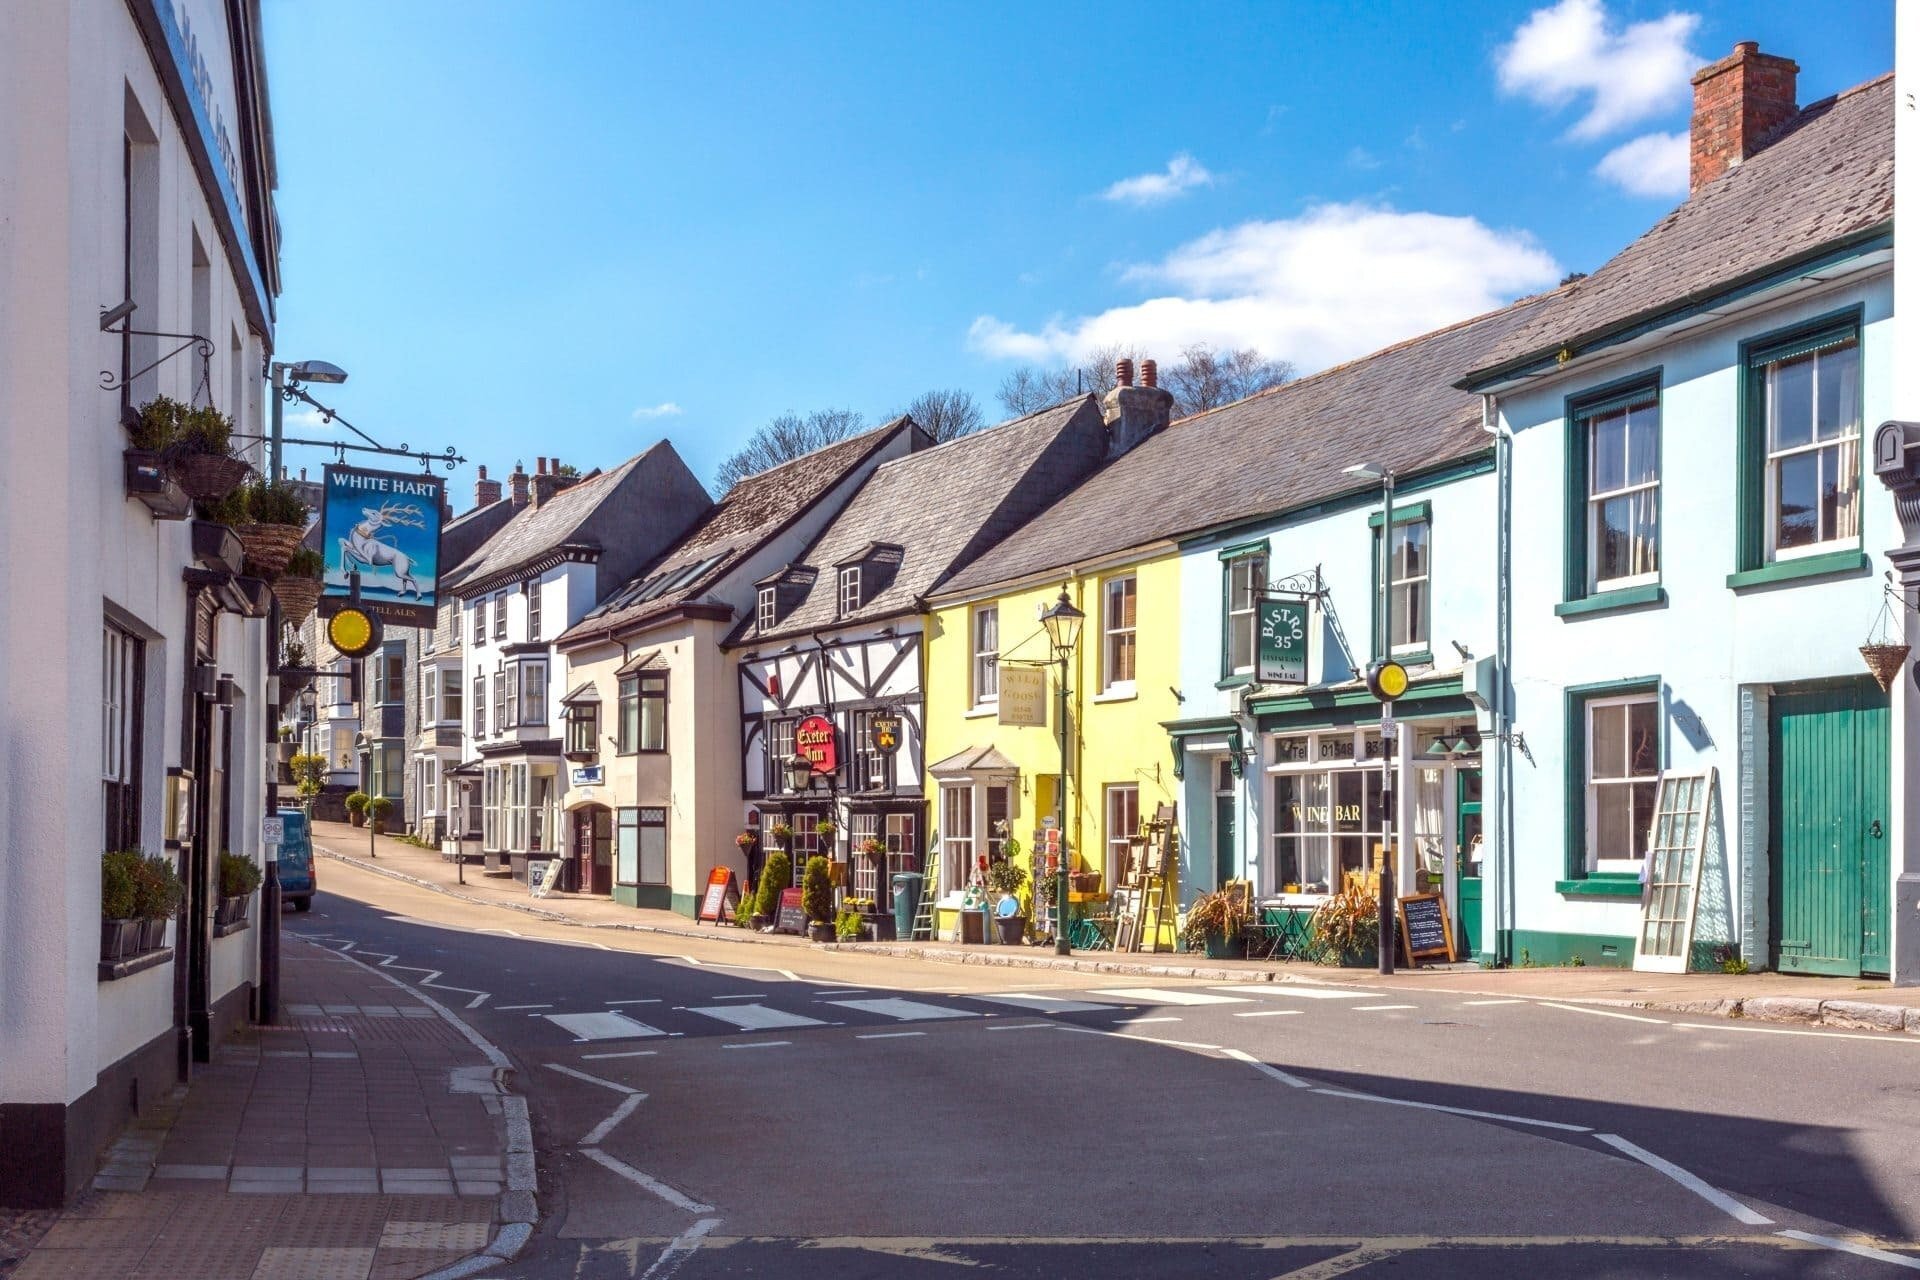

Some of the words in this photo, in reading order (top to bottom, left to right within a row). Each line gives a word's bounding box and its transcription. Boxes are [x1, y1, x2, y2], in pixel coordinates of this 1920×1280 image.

[332, 472, 388, 491] WHITE
[392, 480, 437, 497] HART
[394, 608, 417, 617] ALES
[1262, 608, 1303, 640] BISTRO
[1274, 635, 1291, 649] 35
[1006, 675, 1039, 685] WILD
[1267, 671, 1283, 679] WINE
[1003, 689, 1040, 700] GOOSE
[797, 729, 829, 745] Exeter
[804, 746, 824, 761] Inn
[1292, 744, 1307, 759] Tel
[1292, 806, 1330, 822] WINE
[1335, 804, 1361, 821] BAR
